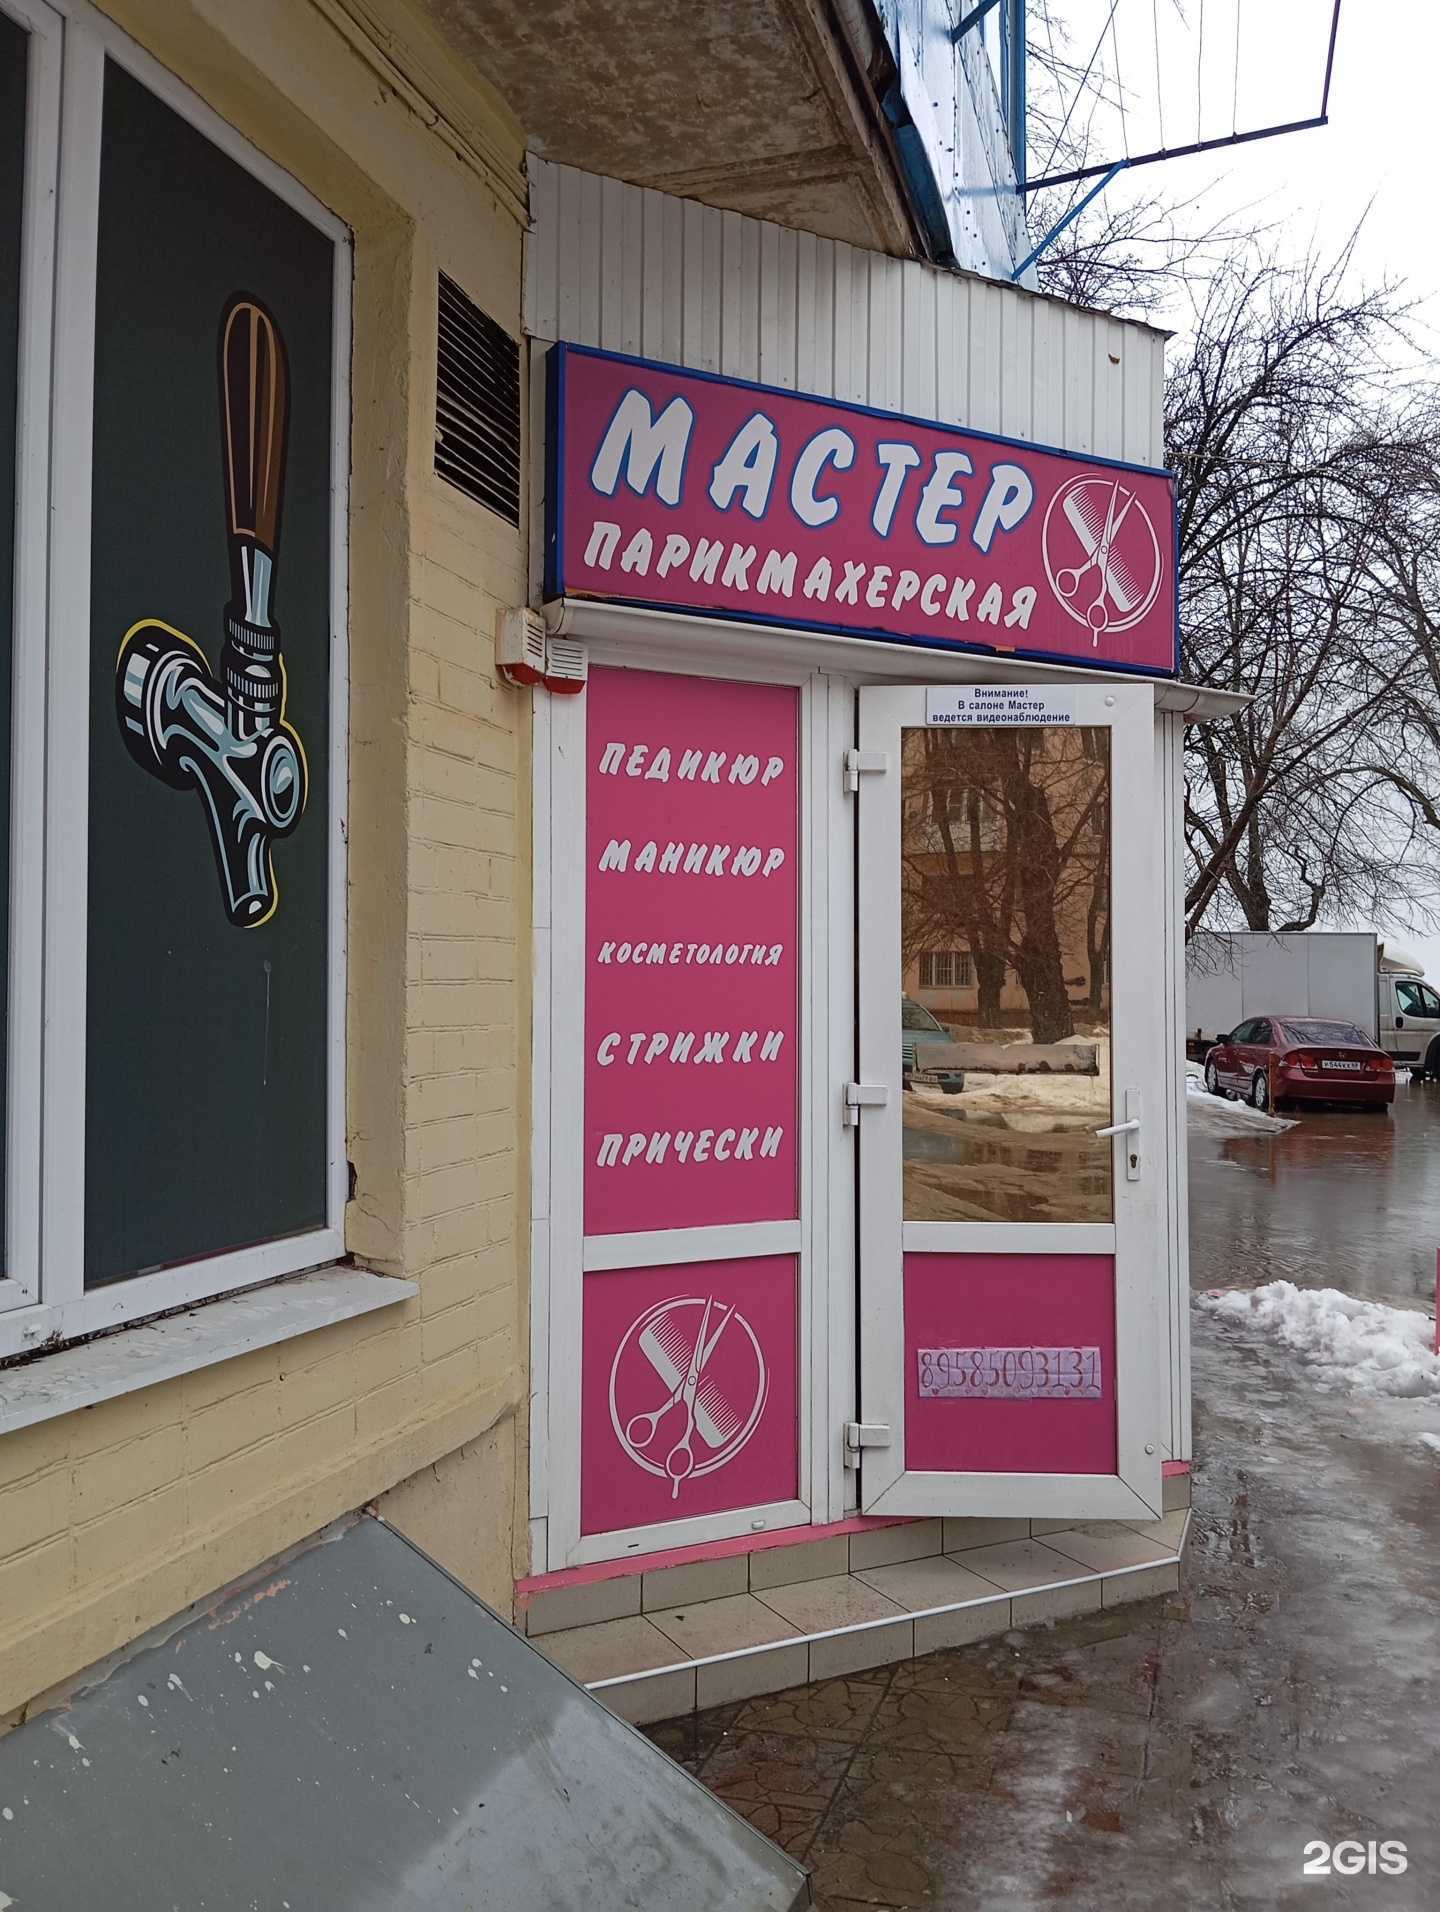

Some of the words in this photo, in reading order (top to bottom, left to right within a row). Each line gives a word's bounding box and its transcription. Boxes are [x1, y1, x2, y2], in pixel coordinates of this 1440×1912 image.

[590, 387, 1036, 555] МАСТЕР
[583, 521, 1038, 631] ПАРИКМАХЕРСКАЯ
[958, 700, 965, 710] В
[969, 702, 1004, 710] салоне
[1008, 700, 1045, 711] Мастер
[974, 688, 1028, 698] Внимание!
[932, 714, 973, 723] ведется
[977, 713, 1070, 723] видеонаблюдение
[599, 742, 784, 786] ПЕДИКЮР
[598, 840, 785, 877] МАНИКЮР
[598, 942, 783, 966] КОСМЕТОЛОГИЯ
[597, 1031, 784, 1066] СТРИЖКИ
[597, 1127, 784, 1167] ПРИЧЕСКИ
[921, 1350, 1100, 1389] 89585093131
